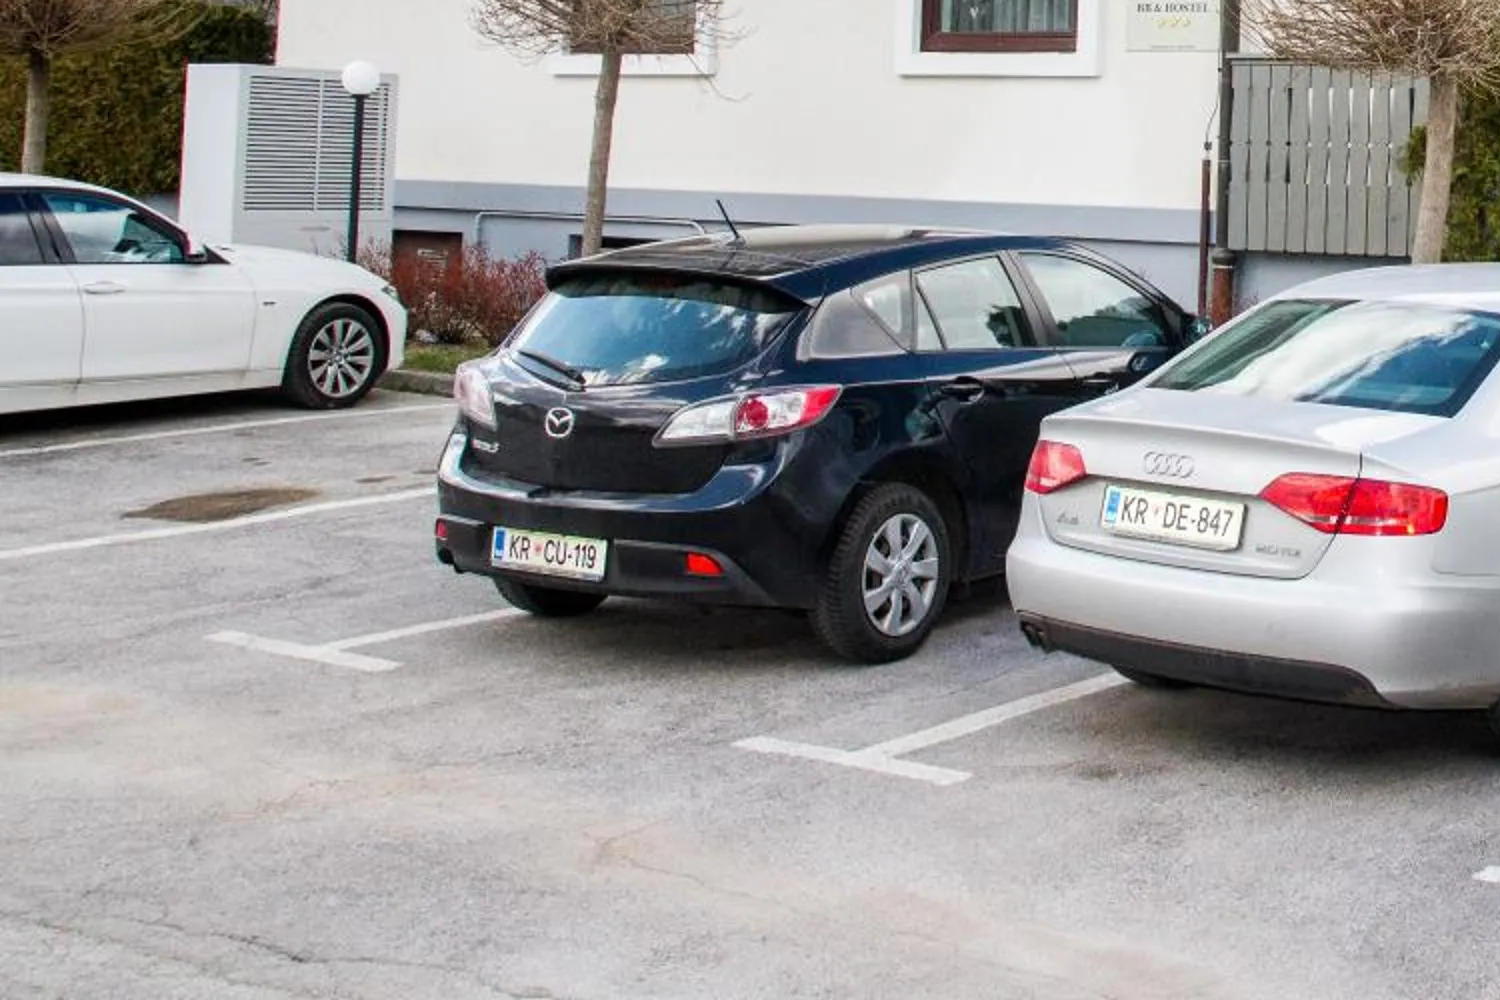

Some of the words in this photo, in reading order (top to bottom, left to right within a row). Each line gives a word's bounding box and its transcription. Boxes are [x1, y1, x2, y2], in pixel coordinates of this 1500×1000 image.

[1121, 495, 1149, 526] KR
[1162, 501, 1234, 538] DE-847
[509, 535, 531, 561] KR
[543, 539, 597, 569] CU-119
